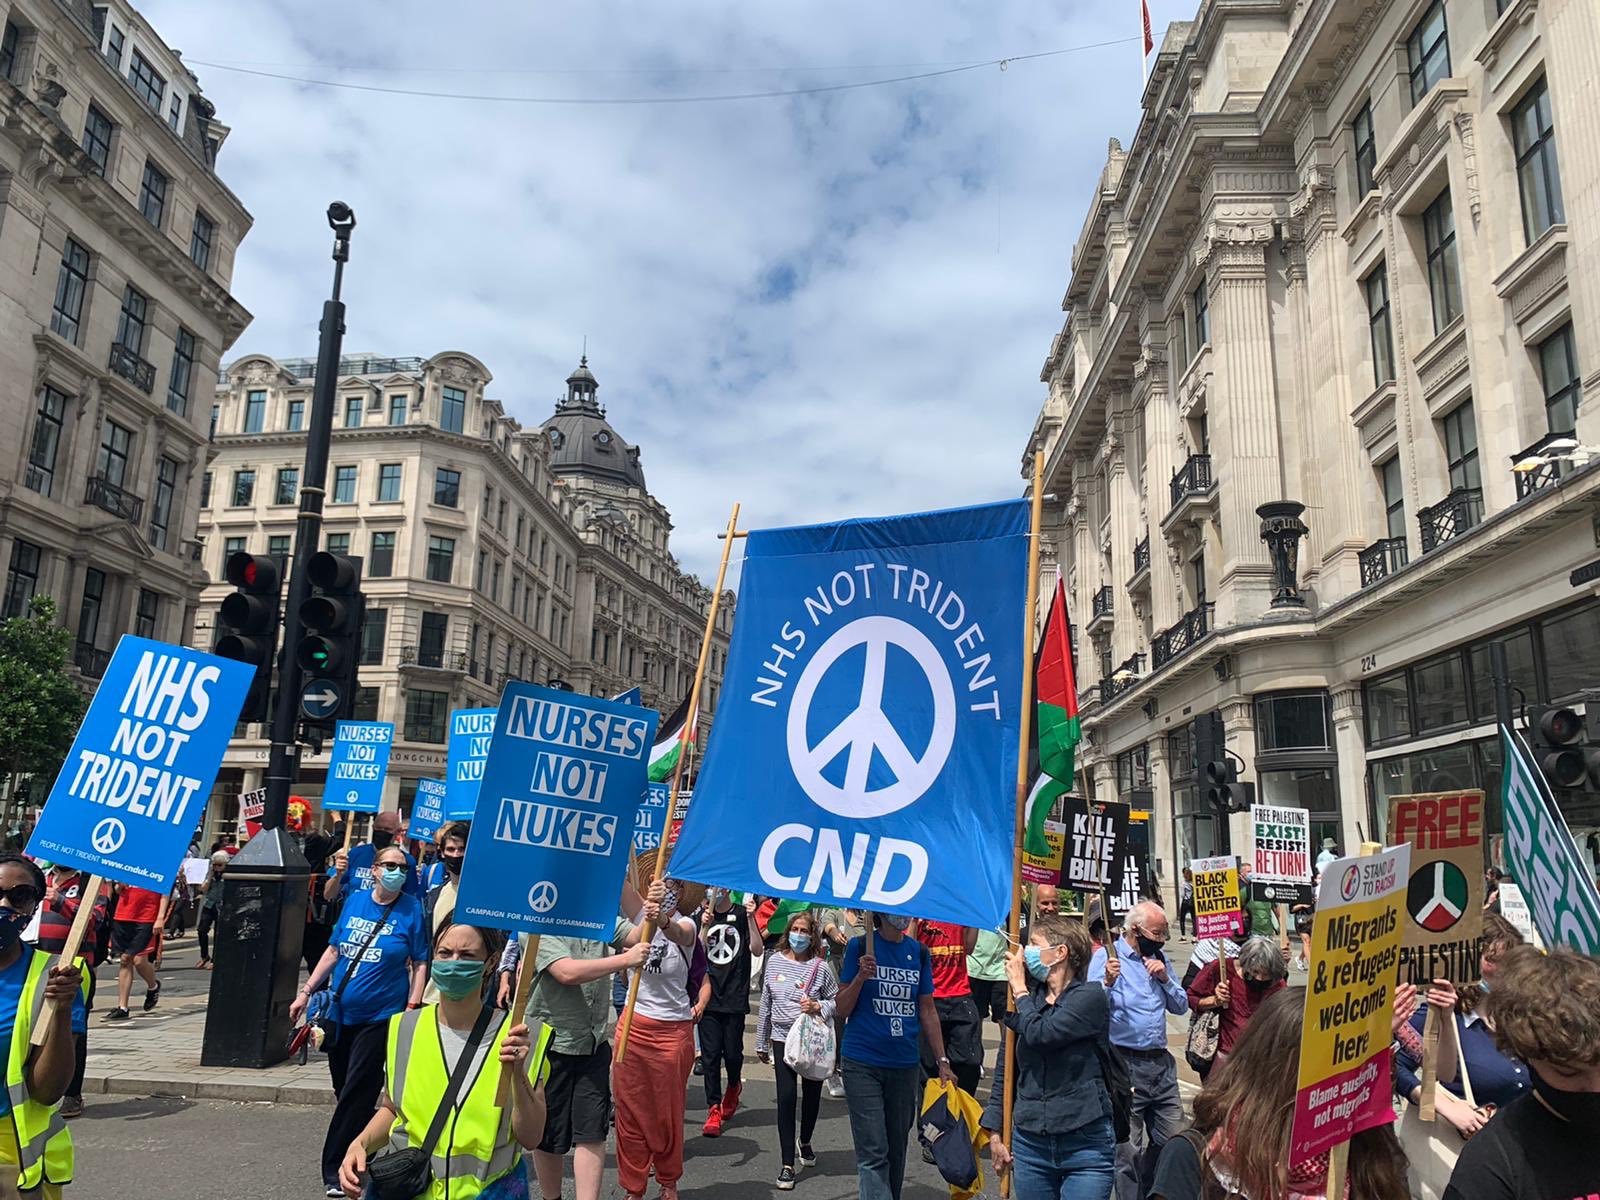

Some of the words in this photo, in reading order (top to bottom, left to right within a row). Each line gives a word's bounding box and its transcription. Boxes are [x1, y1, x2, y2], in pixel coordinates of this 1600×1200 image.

[751, 620, 806, 707] NHS
[803, 563, 875, 626] NOT
[886, 564, 1001, 721] TRIDENT
[1362, 654, 1376, 672] 224
[119, 650, 222, 732] NHS
[457, 714, 497, 732] NUR
[509, 698, 646, 758] NURSES
[110, 718, 190, 767] NOT
[340, 726, 389, 742] NURSES
[348, 745, 375, 760] NOT
[390, 753, 448, 763] LONGCHAM
[336, 763, 379, 779] NUKES
[532, 753, 607, 800] NOT
[68, 749, 201, 825] TRIDENT
[420, 780, 447, 796] NURSE
[244, 789, 266, 807] FRE
[416, 806, 442, 822] NUKES
[1254, 808, 1270, 821] FREE
[1272, 810, 1305, 825] PALESTINE
[1395, 796, 1481, 850] FREE
[496, 800, 616, 854] NUKES
[1073, 813, 1116, 838] KILL
[1255, 824, 1305, 840] EXIST!
[634, 831, 659, 849] KES
[1072, 834, 1115, 861] THE
[1255, 839, 1306, 852] RESIST!
[39, 839, 61, 852] PEOPLE
[60, 845, 75, 856] NOT
[75, 848, 100, 862] TRIDENT
[101, 858, 165, 882] www.cnduk.org
[757, 822, 929, 906] CND
[1028, 855, 1047, 866] here
[1069, 857, 1112, 884] BILL
[1255, 850, 1306, 877] RETURN!
[1363, 861, 1388, 880] STAND
[1387, 858, 1395, 873] UP
[1195, 871, 1228, 886] BLACK
[1363, 881, 1374, 896] TO
[1375, 872, 1396, 895] RACISM
[1196, 885, 1225, 899] LIVES
[1197, 896, 1239, 912] MATTER
[465, 906, 505, 918] CAMPAIGN
[506, 912, 522, 921] FOR
[523, 914, 555, 924] NUCLEAR
[556, 918, 606, 930] DISARMAMENT
[1198, 916, 1207, 925] No
[1208, 914, 1229, 926] justice
[1199, 925, 1208, 933] No
[1208, 924, 1227, 933] peace
[1327, 905, 1397, 953] Migrants
[341, 944, 381, 961] NUES
[876, 967, 919, 984] URSES
[1314, 960, 1327, 994] &
[1332, 944, 1397, 986] refugees
[880, 982, 911, 998] NOT
[874, 1000, 915, 1016] NUKES
[1320, 985, 1386, 1032] welcome
[1332, 1031, 1369, 1066] here
[1308, 1082, 1339, 1110] Blame
[1314, 1109, 1331, 1129] not
[1332, 1087, 1370, 1119] migrants
